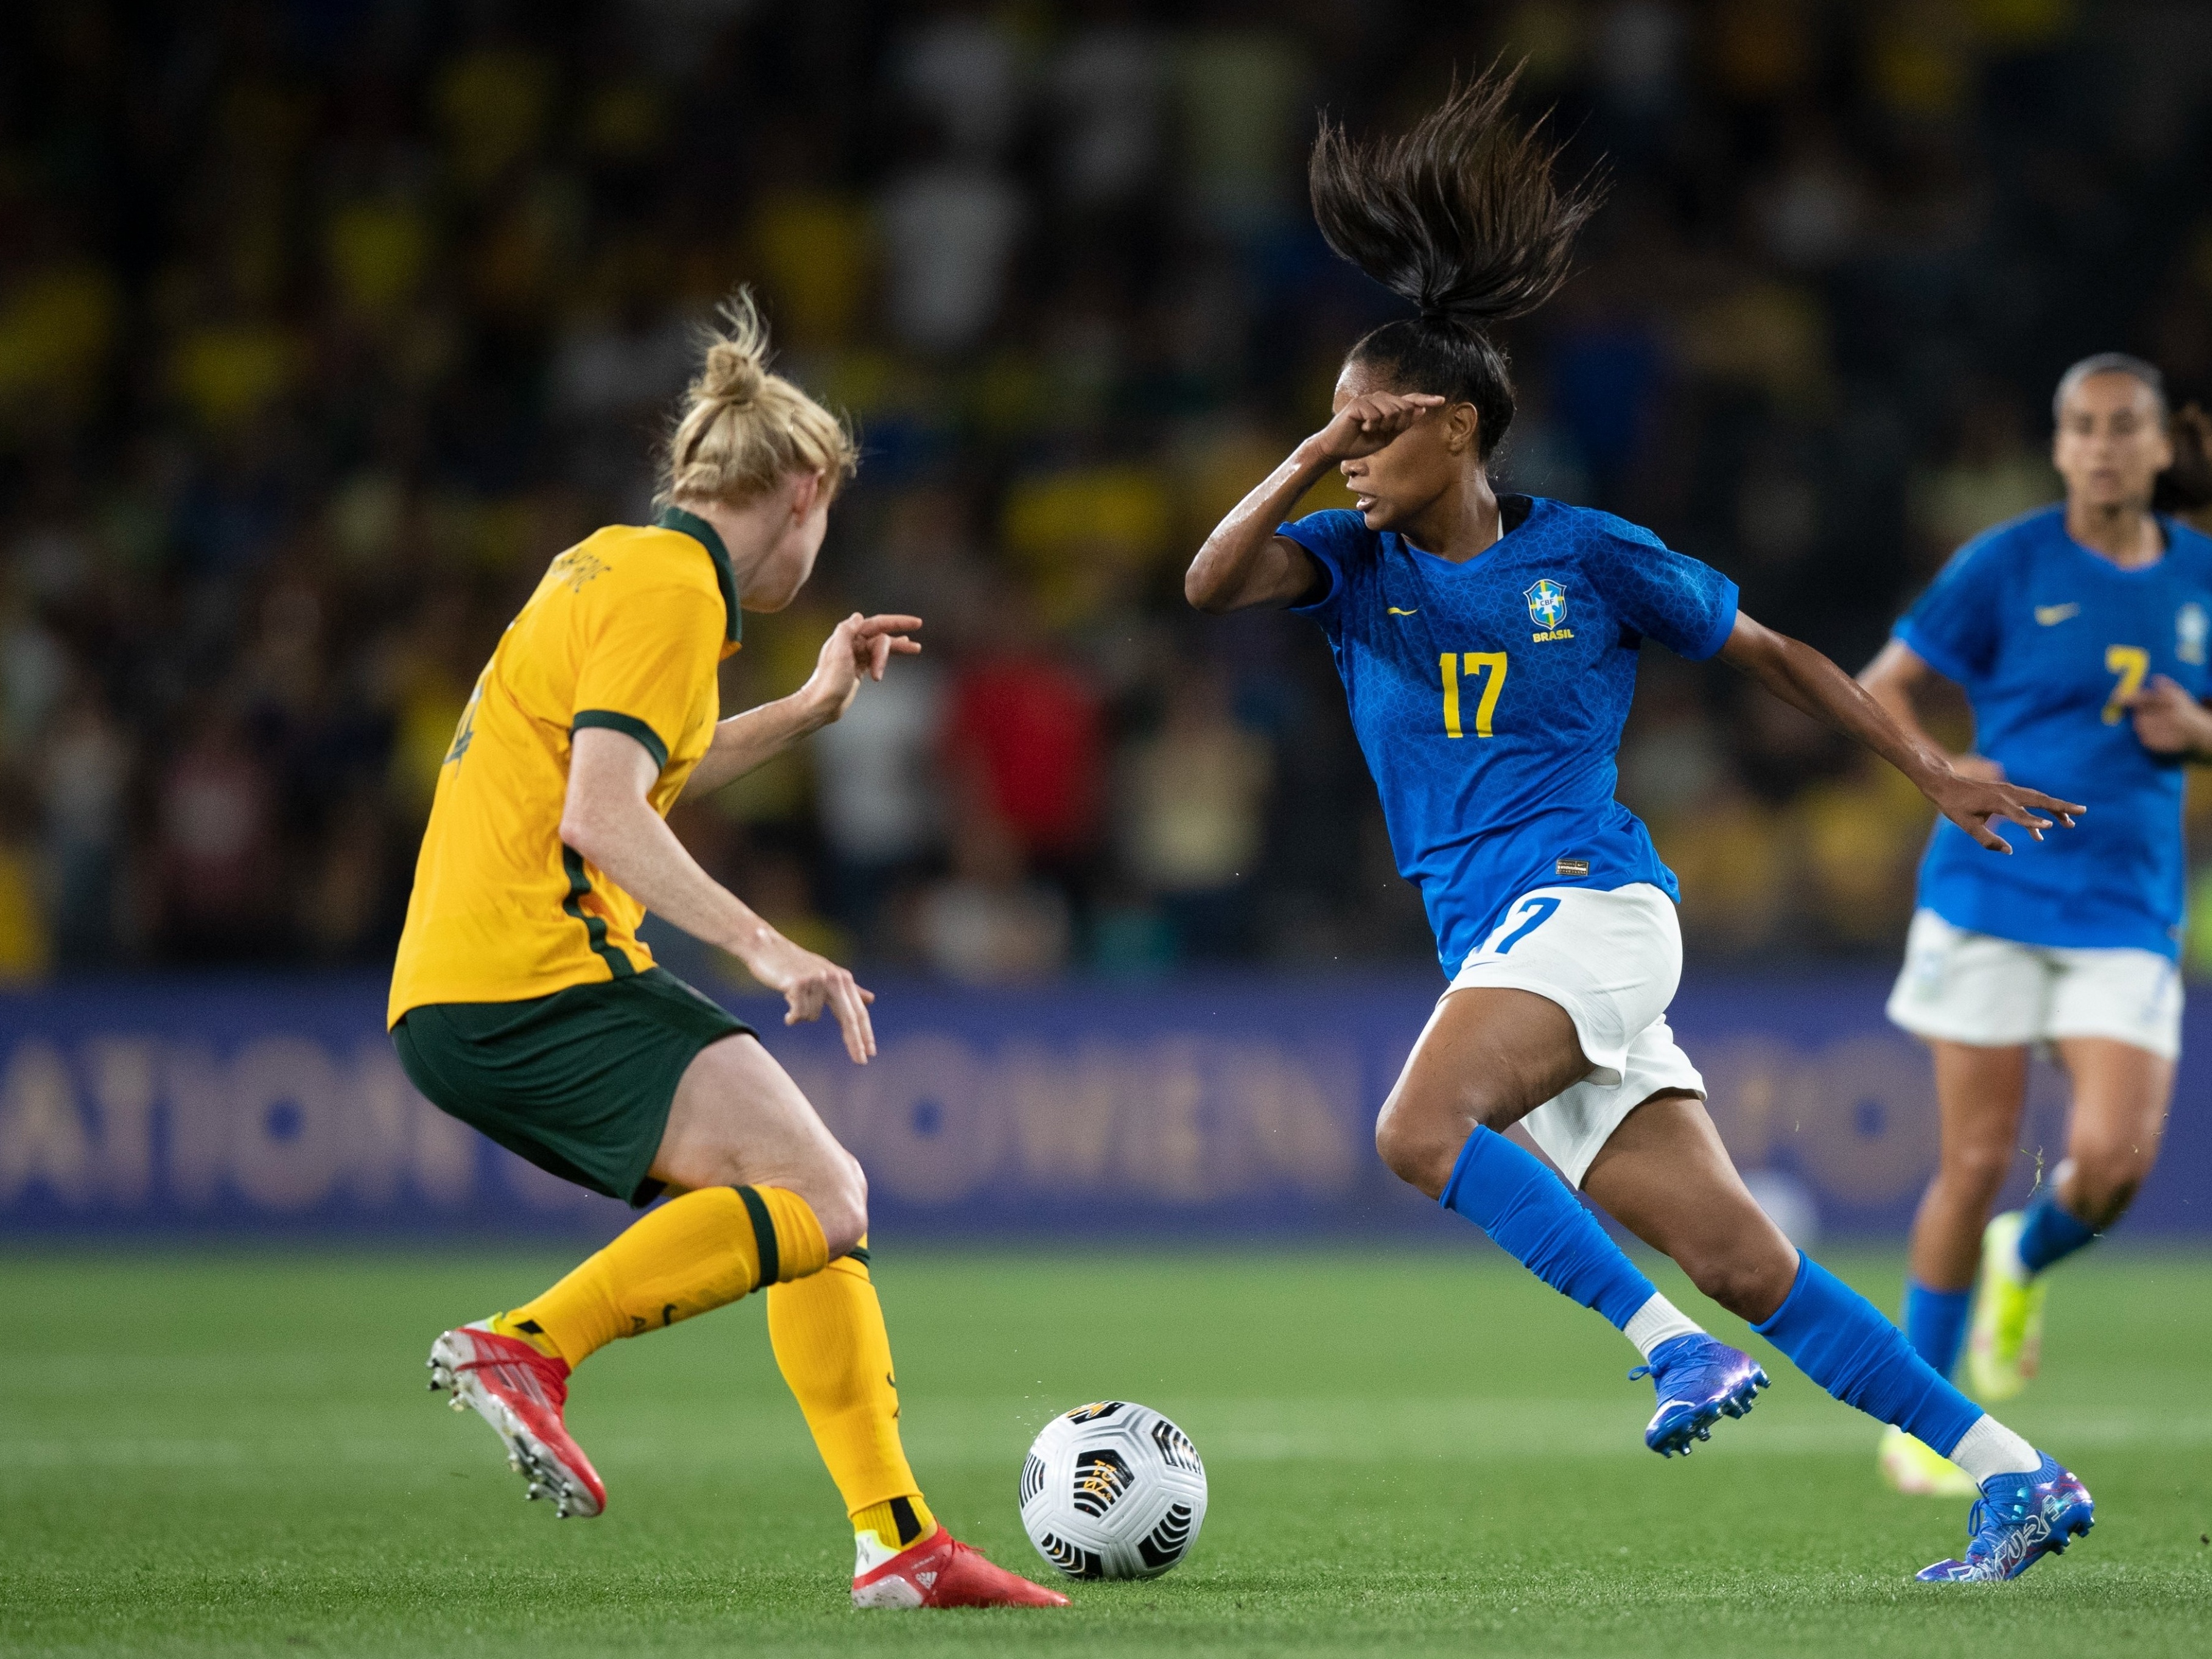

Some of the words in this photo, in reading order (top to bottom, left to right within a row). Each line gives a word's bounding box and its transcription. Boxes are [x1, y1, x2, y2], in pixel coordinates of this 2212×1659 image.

[1540, 598, 1554, 607] CBF
[1533, 629, 1575, 643] BRASIL
[1439, 652, 1507, 738] 17
[2101, 643, 2150, 726] 7
